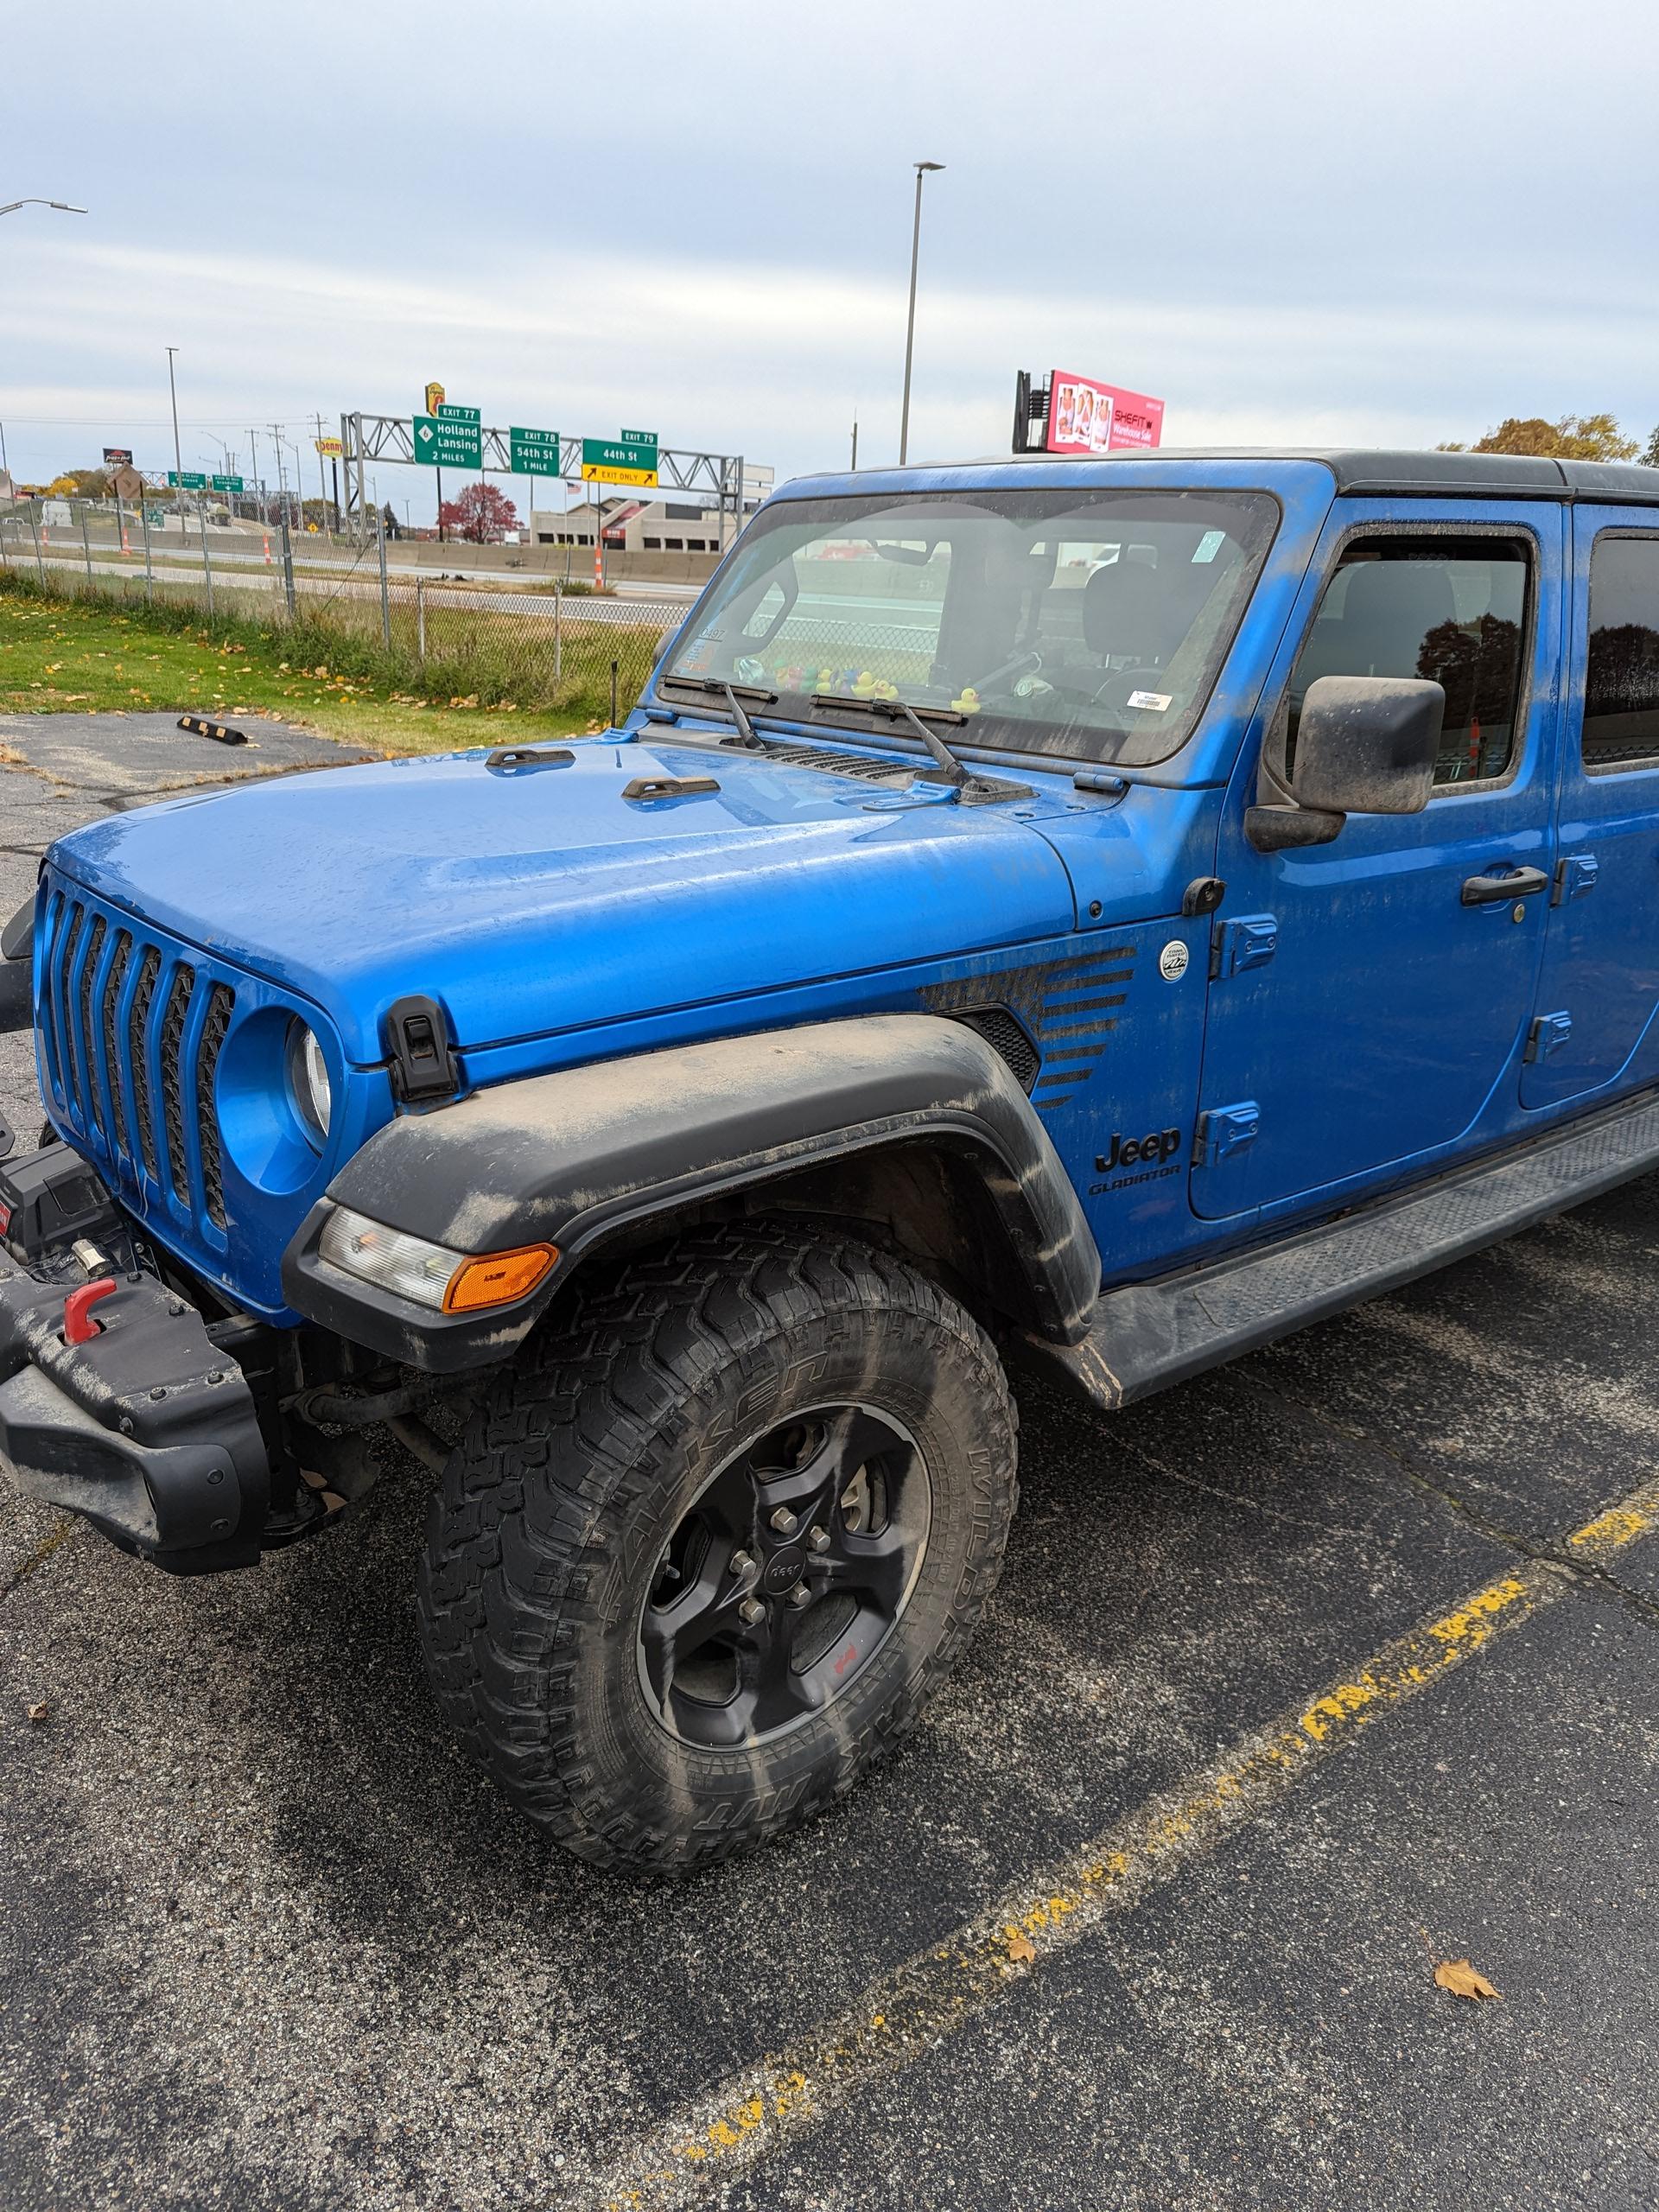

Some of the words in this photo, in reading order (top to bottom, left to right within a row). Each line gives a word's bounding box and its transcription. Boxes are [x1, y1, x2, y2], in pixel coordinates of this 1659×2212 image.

[443, 408, 461, 416] EXIT
[464, 410, 475, 419] 77
[1115, 410, 1146, 428] SHEFIT
[423, 429, 429, 438] 6
[437, 423, 478, 437] Holland
[524, 431, 541, 441] EXIT
[544, 433, 556, 443] 78
[644, 435, 654, 443] 79
[437, 437, 478, 453] Lansing
[432, 451, 438, 461] 2
[442, 453, 465, 462] MILES
[517, 448, 540, 458] 54th
[543, 449, 553, 461] St
[603, 448, 626, 461] 44th
[628, 451, 638, 462] St
[530, 462, 548, 471] MILE
[601, 471, 617, 480] EXIT
[620, 473, 639, 481] ONLY
[1095, 1128, 1180, 1173] Jeep
[1089, 1165, 1182, 1196] GLADIATOR
